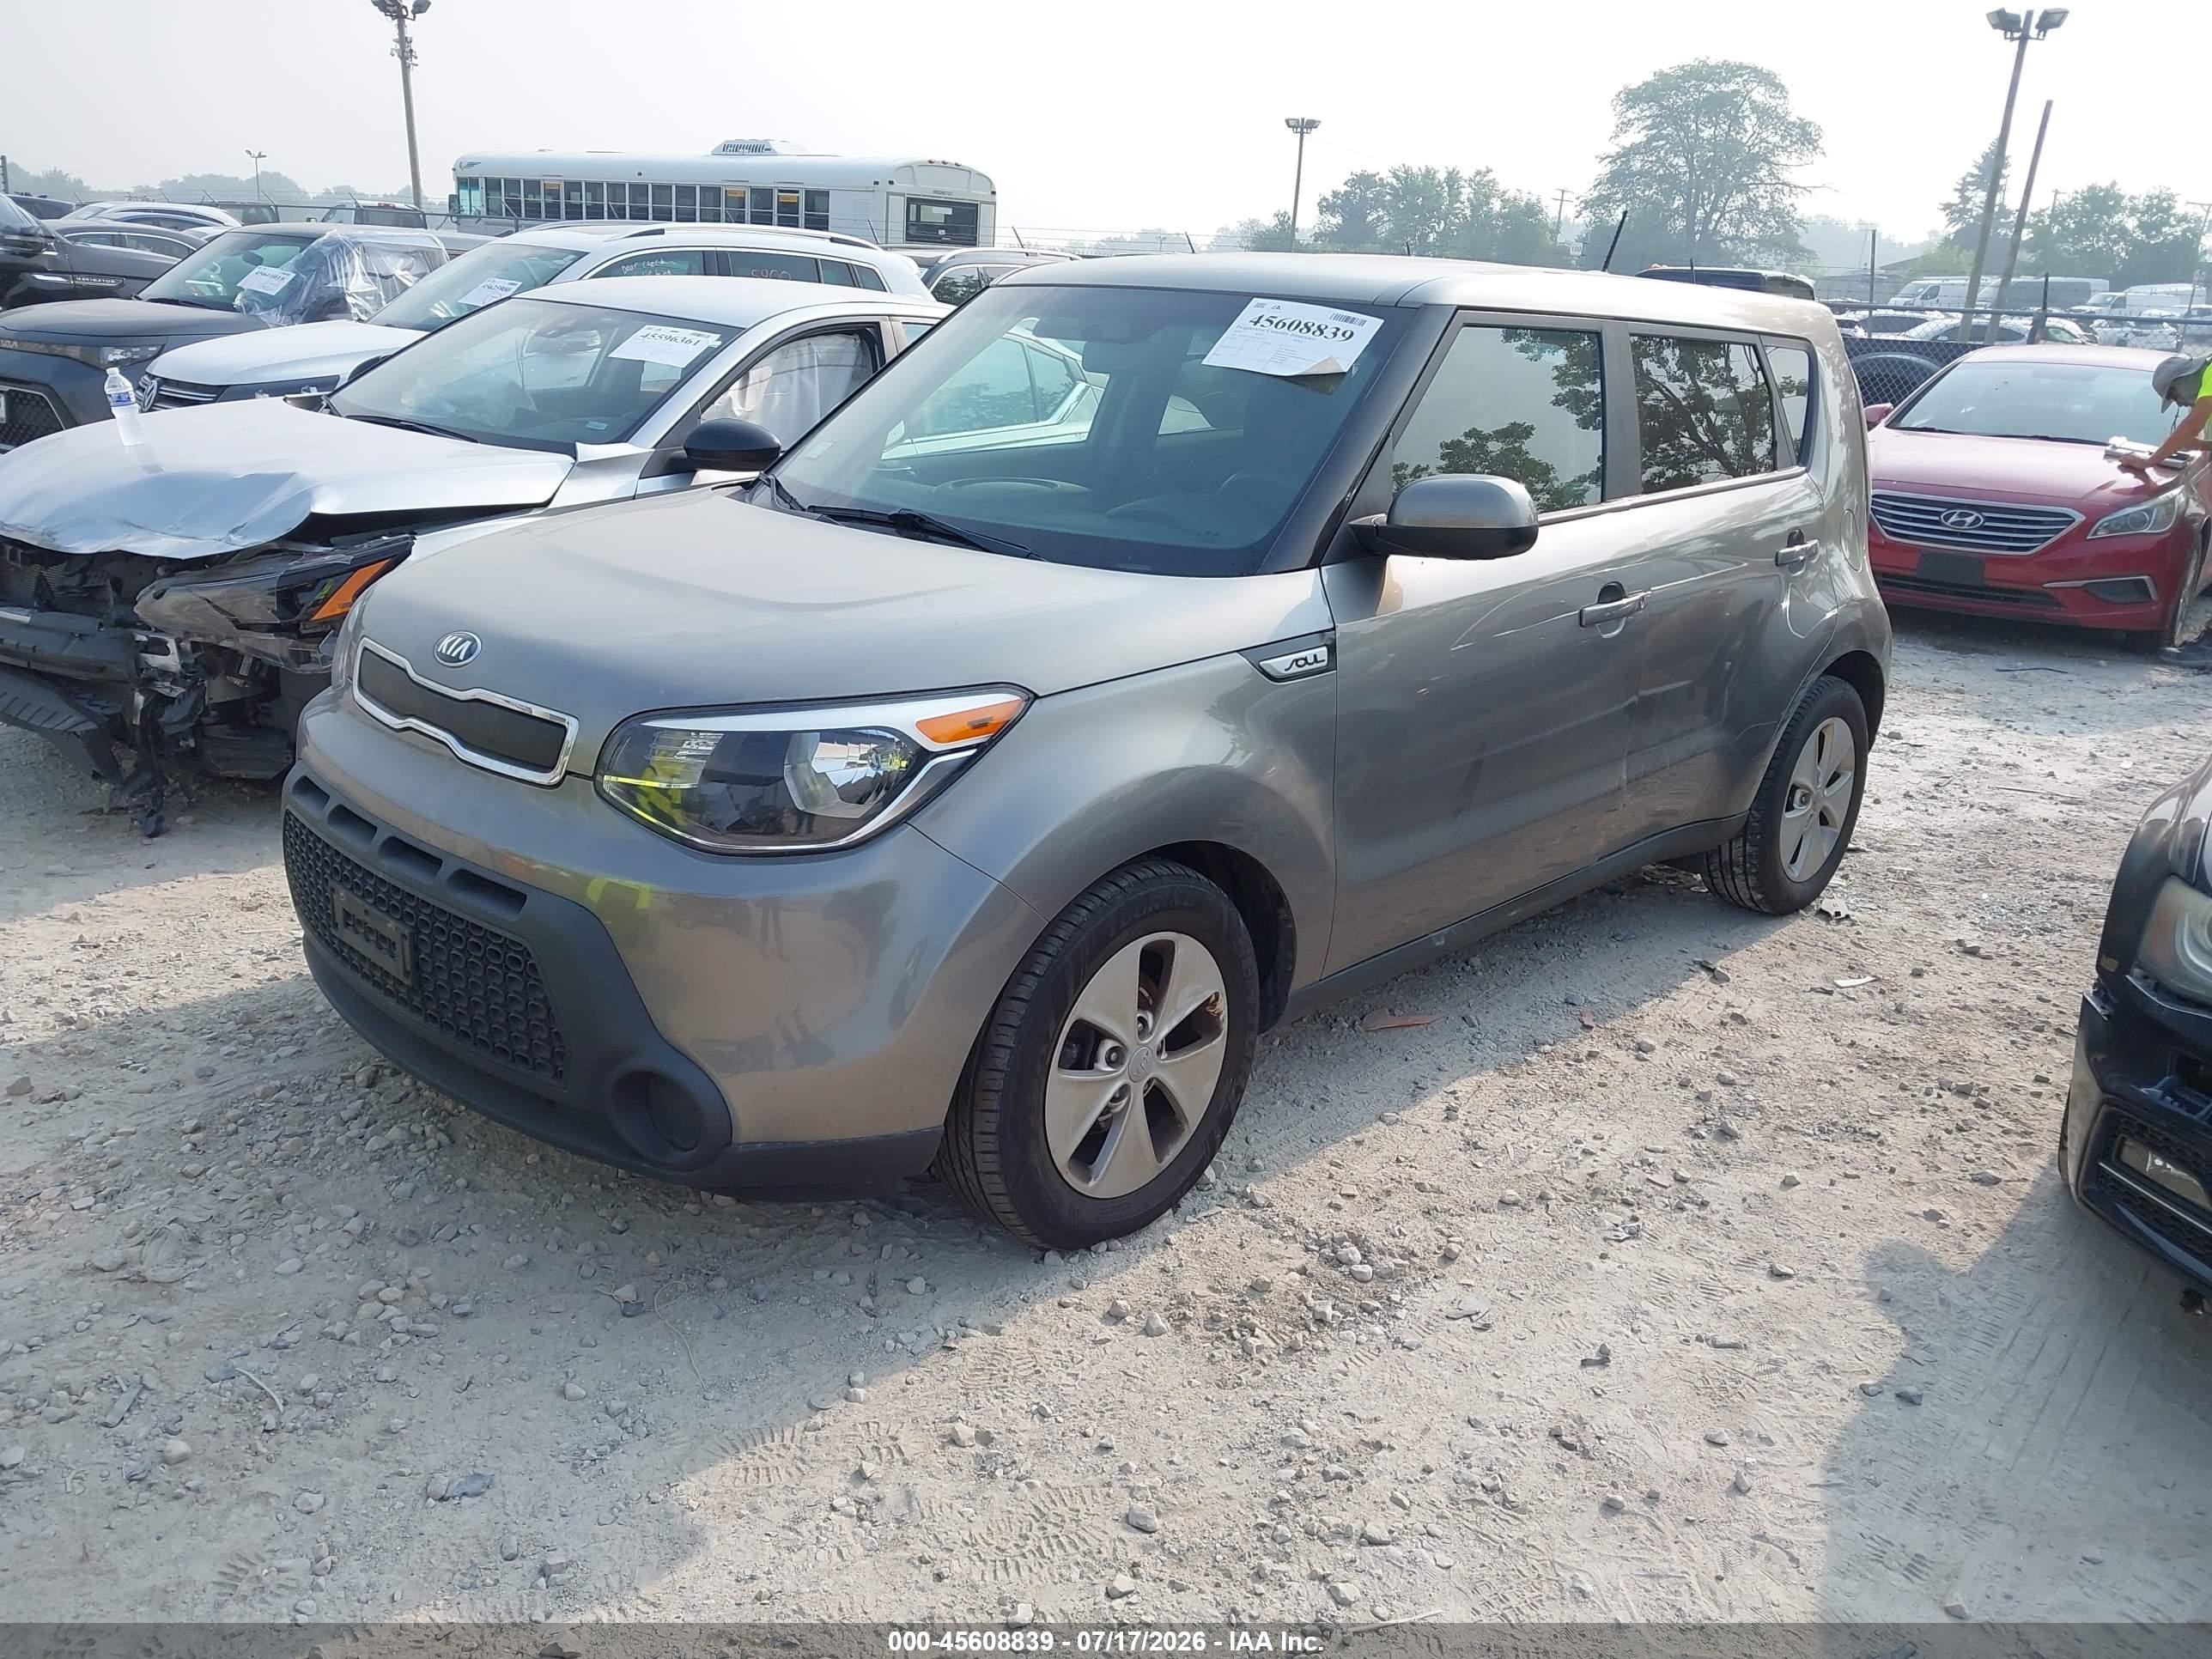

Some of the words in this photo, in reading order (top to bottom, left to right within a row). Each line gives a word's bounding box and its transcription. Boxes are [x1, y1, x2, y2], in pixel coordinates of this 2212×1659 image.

[641, 332, 700, 345] 45596361
[1249, 314, 1354, 342] 45608839
[437, 635, 472, 660] KIA
